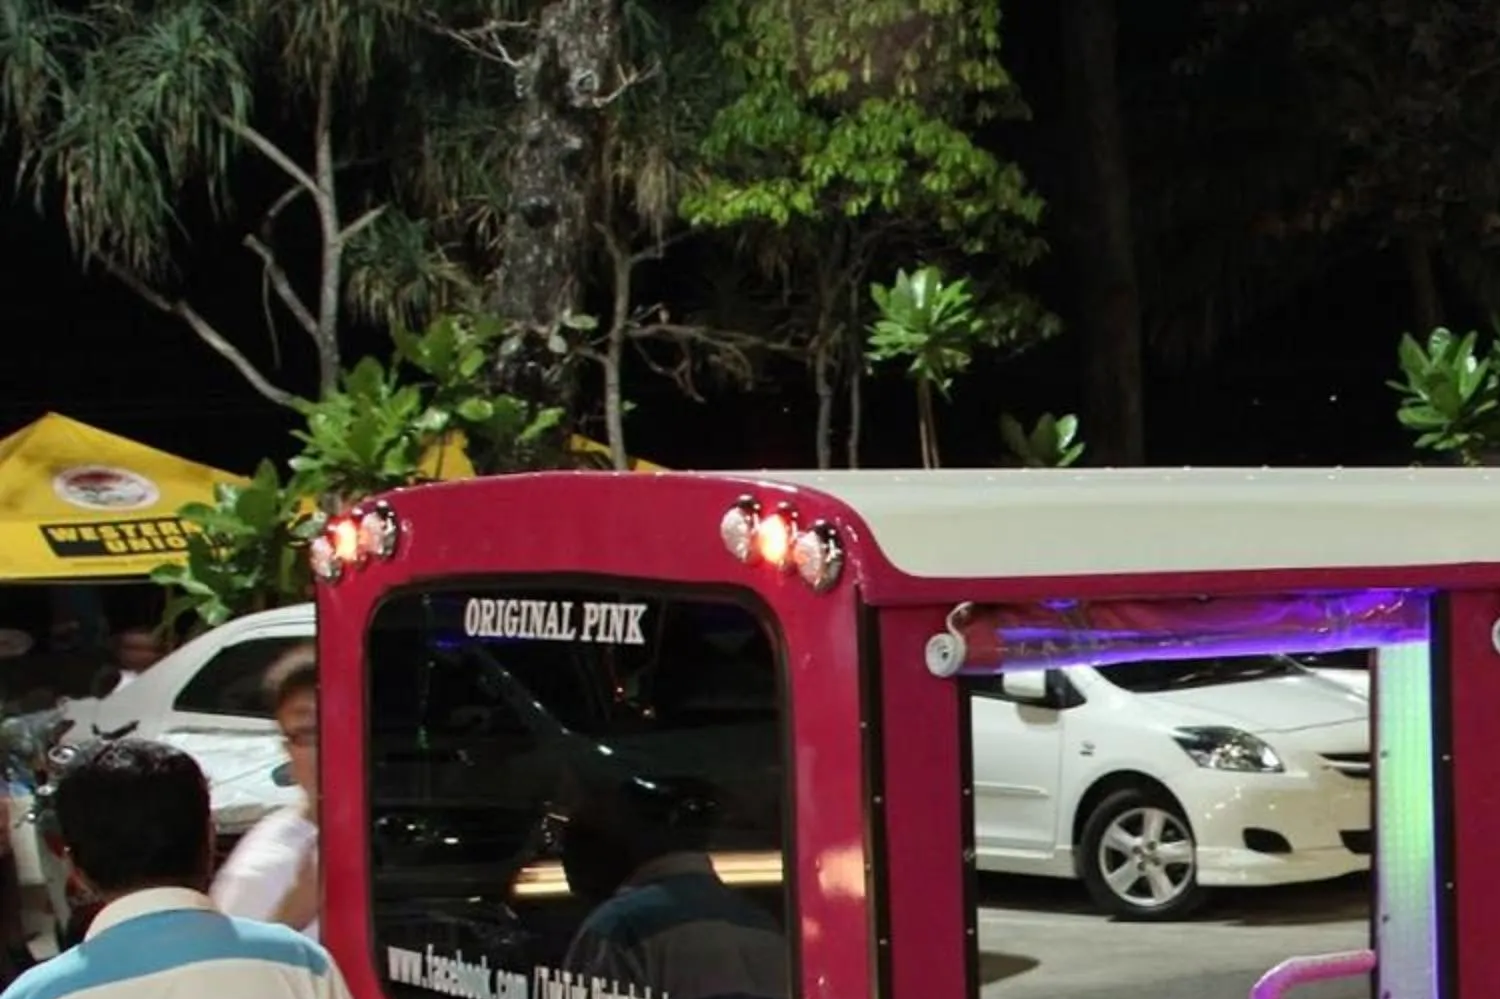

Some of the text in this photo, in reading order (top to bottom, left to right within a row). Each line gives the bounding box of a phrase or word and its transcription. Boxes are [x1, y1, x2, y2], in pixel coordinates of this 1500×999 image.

[103, 535, 188, 553] UNIO
[464, 598, 648, 645] ORIGINAL PINK
